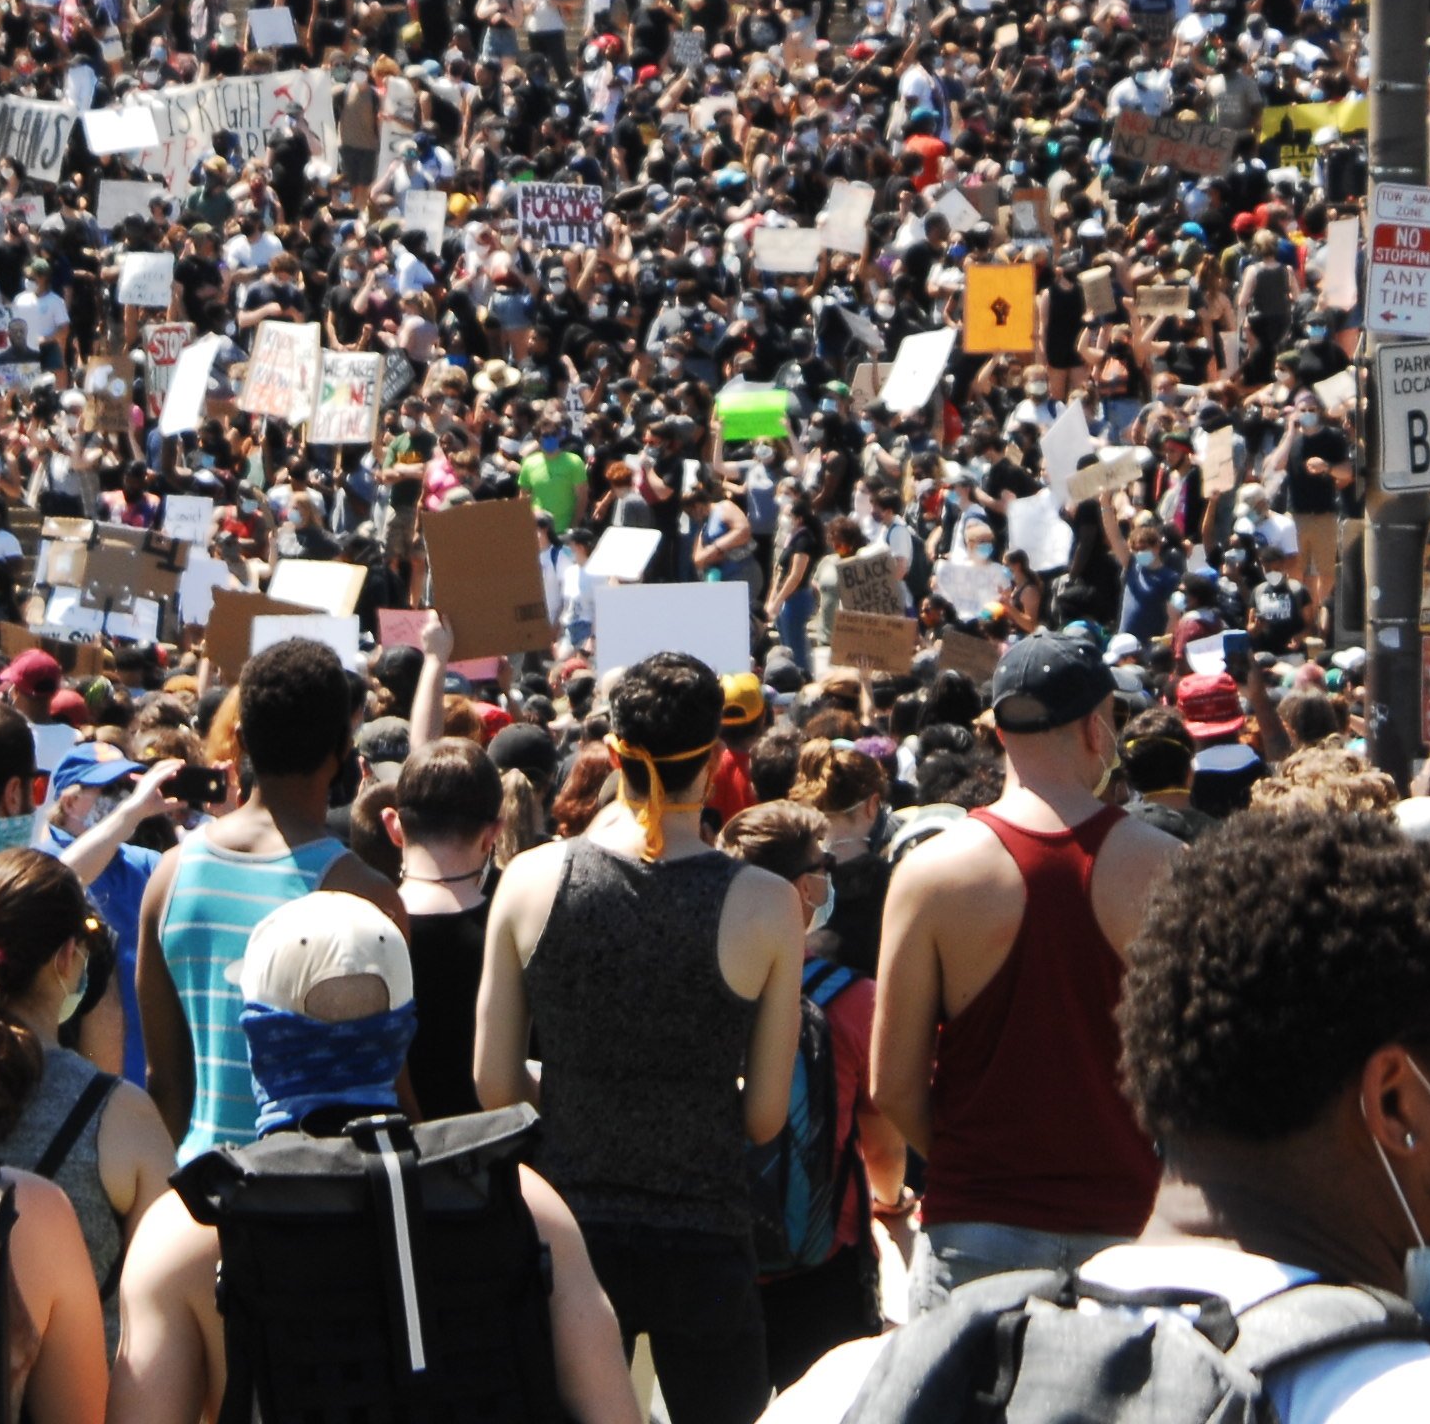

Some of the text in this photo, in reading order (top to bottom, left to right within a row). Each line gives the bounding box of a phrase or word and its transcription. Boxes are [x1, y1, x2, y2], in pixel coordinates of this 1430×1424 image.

[196, 80, 263, 132] RIGHT
[1148, 116, 1230, 150] JUSTICE
[1118, 134, 1221, 171] NO PEACE
[1382, 190, 1404, 202] TOW
[521, 197, 603, 224] FUCKING
[1395, 205, 1424, 218] ZONE
[521, 221, 602, 246] MATTER
[1395, 226, 1421, 248] NO
[1383, 269, 1427, 287] ANY
[1379, 288, 1428, 307] TIME
[324, 358, 375, 376] WE ARE
[322, 381, 374, 407] DONE
[842, 556, 891, 589] BLACK
[851, 579, 892, 604] LIVES
